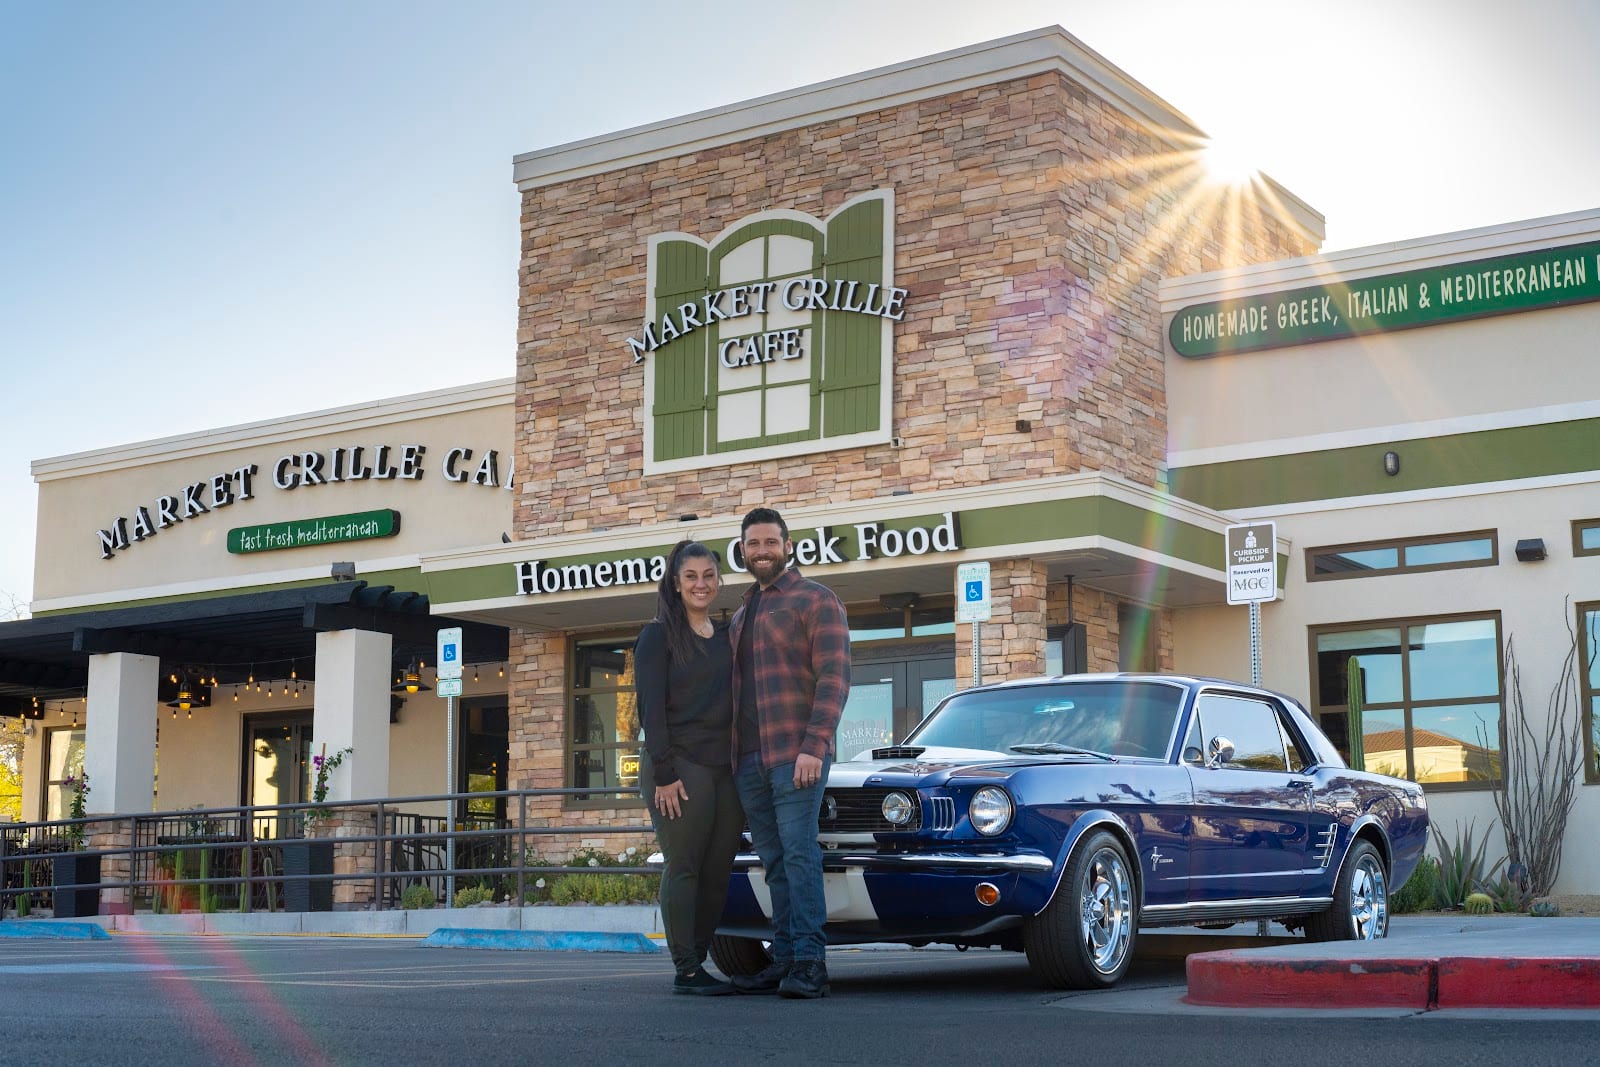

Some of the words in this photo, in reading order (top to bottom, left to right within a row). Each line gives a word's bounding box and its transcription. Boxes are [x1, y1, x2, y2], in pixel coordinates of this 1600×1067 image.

[1182, 304, 1268, 343] HOMEMADE
[1277, 296, 1339, 328] GREEK,
[1347, 283, 1409, 319] ITALIAN
[1418, 283, 1431, 309] &
[1440, 257, 1587, 306] MEDITERRANEAN
[625, 282, 776, 364] MARKET
[782, 278, 911, 322] GRILLE
[719, 329, 804, 369] CAFE
[95, 464, 258, 560] MARKET
[272, 444, 427, 490] GRILLE
[442, 447, 514, 491] CA
[240, 529, 262, 551] fast
[265, 525, 293, 547] fresh
[297, 519, 379, 545] mediterranean
[513, 555, 667, 596] Homema
[727, 526, 843, 573] Gek
[854, 511, 960, 560] Food
[1233, 548, 1269, 556] CURBSIDE
[1238, 555, 1264, 563] PICKUP
[1234, 576, 1269, 591] MGC
[842, 727, 887, 741] MARKET
[623, 761, 640, 773] OP
